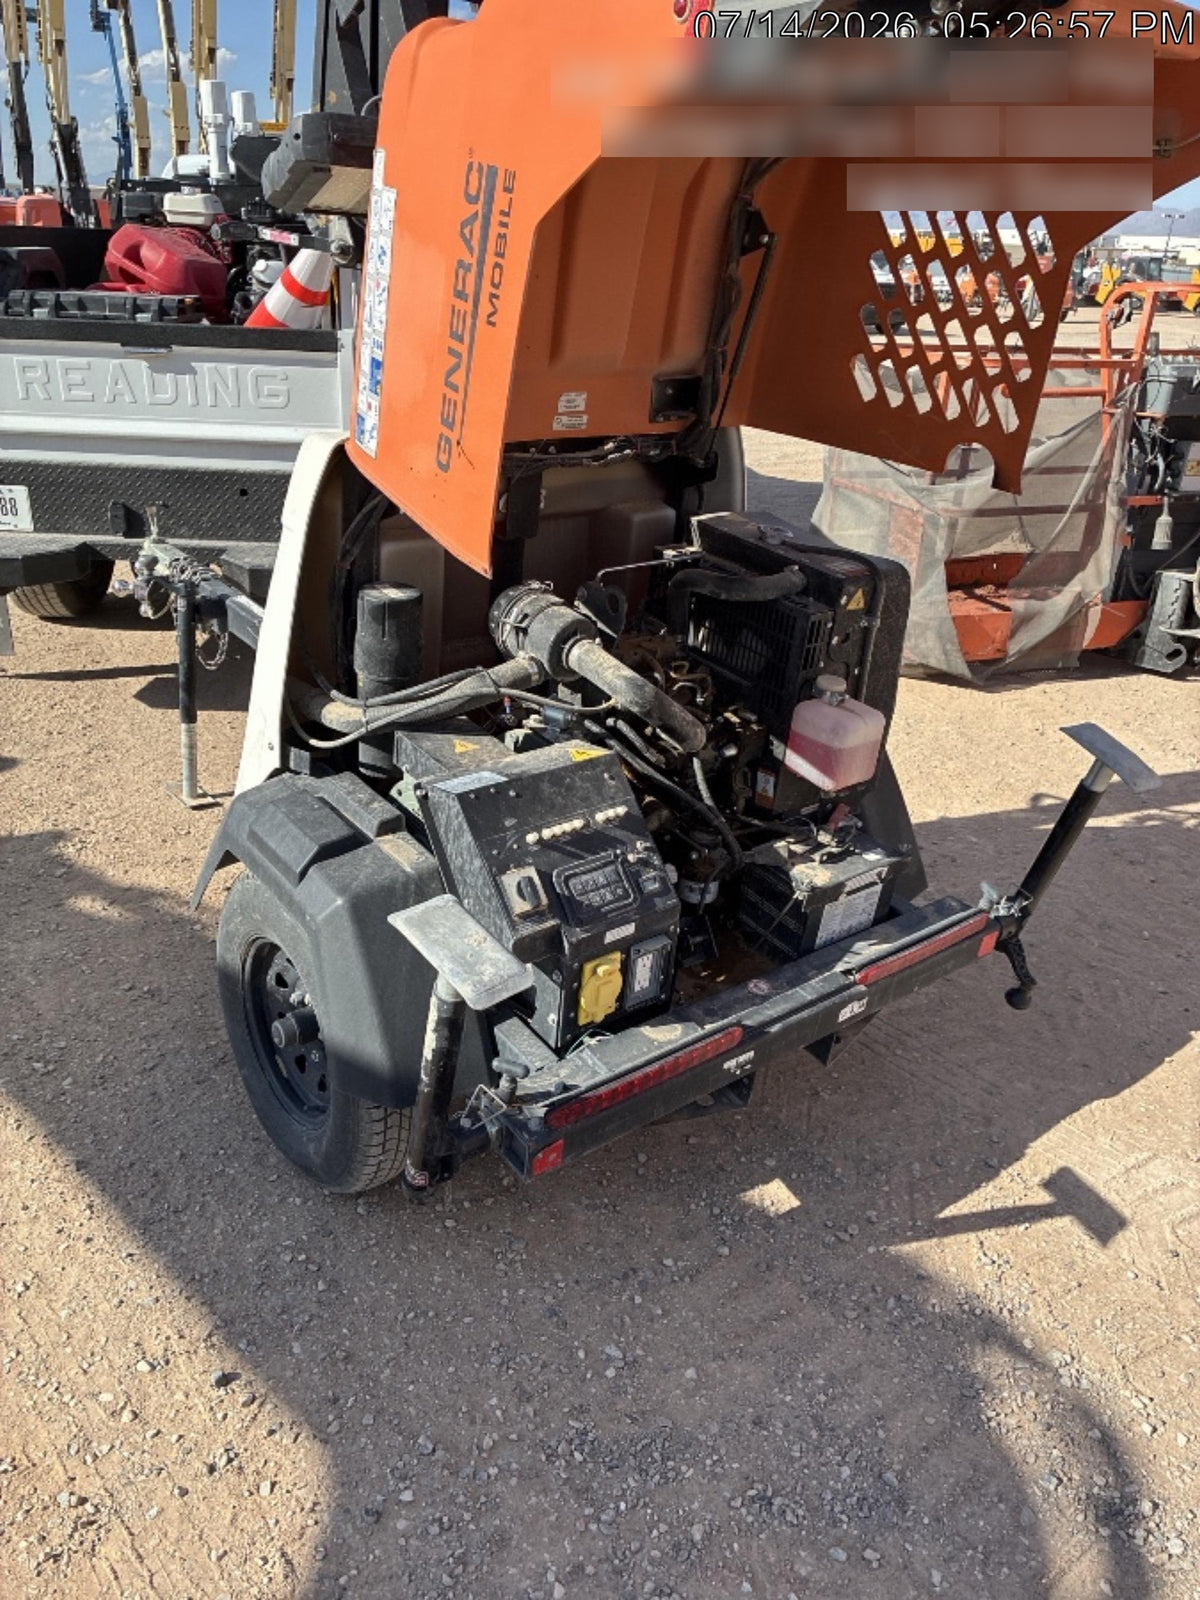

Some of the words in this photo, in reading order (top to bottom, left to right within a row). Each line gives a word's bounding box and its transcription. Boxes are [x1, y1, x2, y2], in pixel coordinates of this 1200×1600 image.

[436, 161, 484, 473] GENERAC
[486, 168, 516, 327] MOBILE
[13, 357, 291, 409] READING
